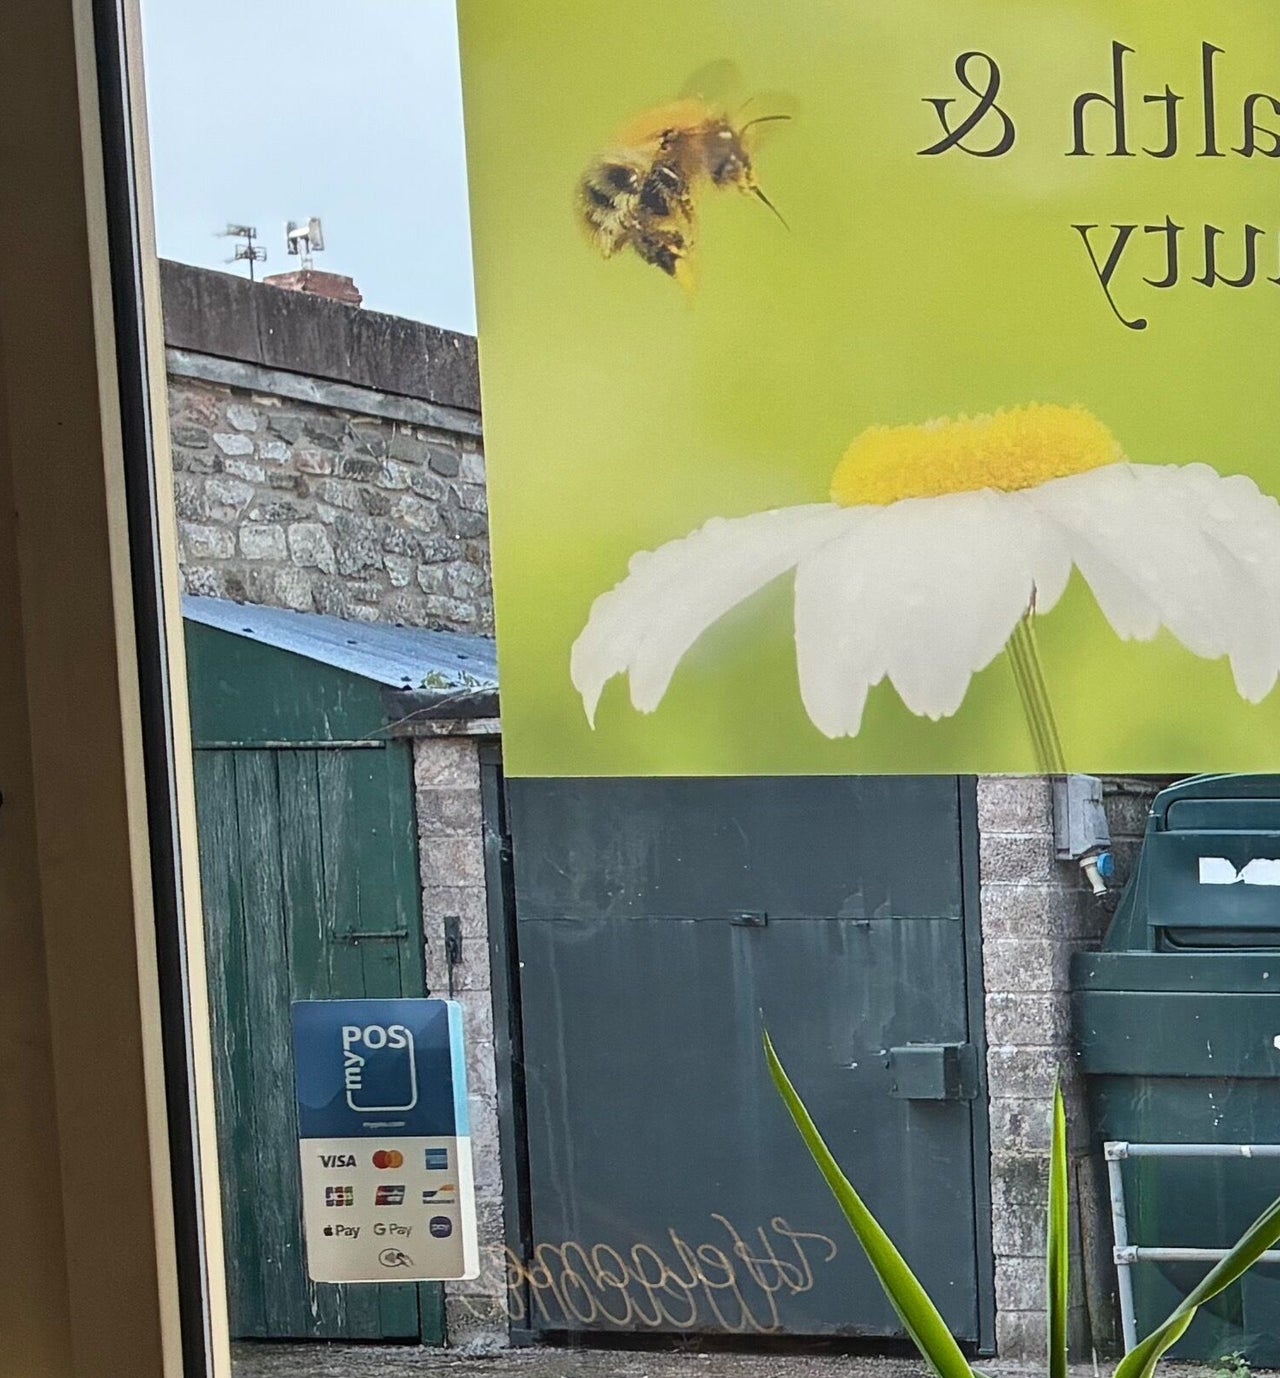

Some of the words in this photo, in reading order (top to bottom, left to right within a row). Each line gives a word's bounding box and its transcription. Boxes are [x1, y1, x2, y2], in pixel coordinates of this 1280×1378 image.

[318, 1154, 357, 1168] VISA
[335, 1224, 360, 1238] Pay
[389, 1223, 412, 1238] Pay
